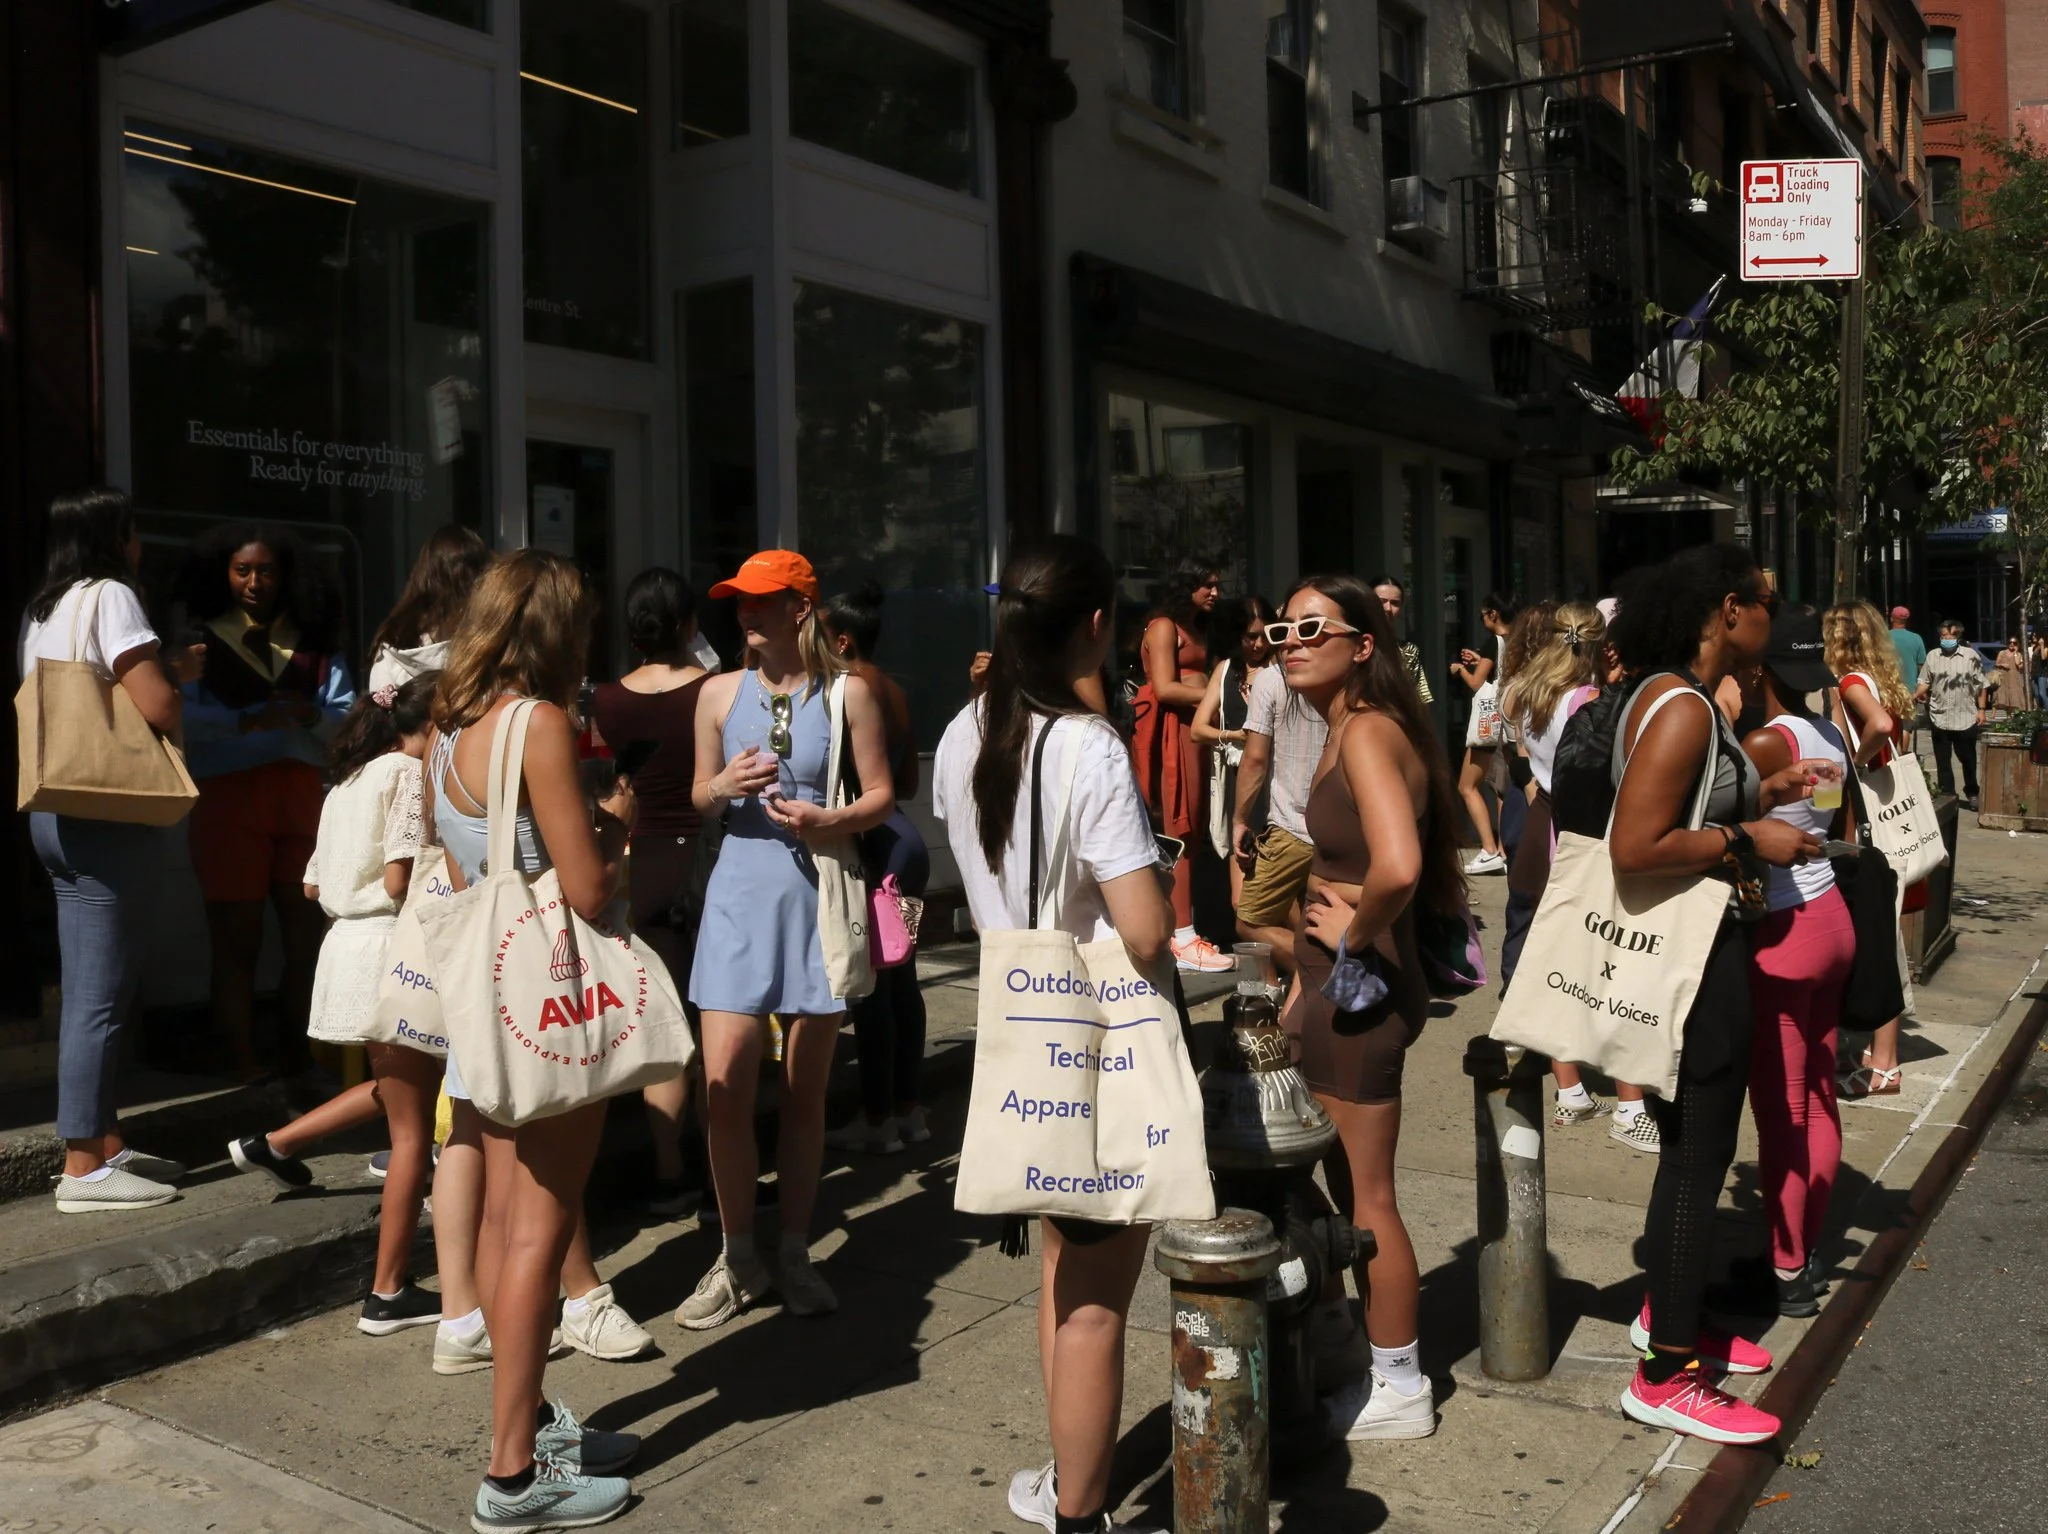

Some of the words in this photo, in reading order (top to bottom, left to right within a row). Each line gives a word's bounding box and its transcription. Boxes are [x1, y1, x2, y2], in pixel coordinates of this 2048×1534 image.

[1787, 167, 1818, 178] Truck
[1787, 179, 1829, 192] Loading
[1787, 192, 1811, 205] Only
[1748, 216, 1789, 228] Monday
[1800, 215, 1832, 228] Friday
[1748, 231, 1772, 242] 8am
[1782, 230, 1805, 243] 6pm
[522, 297, 561, 314] entre
[186, 419, 288, 454] Essentials
[292, 430, 321, 456] for
[250, 455, 312, 492] Ready
[316, 461, 344, 485] for
[348, 469, 427, 501] anything.
[1960, 519, 2003, 530] LEASE
[1584, 911, 1664, 956] GOLDE
[493, 930, 516, 983] THANK
[636, 967, 648, 1017] THANK
[1006, 968, 1092, 998] Outdoo
[1089, 977, 1159, 1004] Voices
[1547, 971, 1605, 1011] Outdoor
[1608, 997, 1660, 1027] Voices
[538, 981, 625, 1032] AWA
[498, 1005, 571, 1066] EXPLORING
[611, 1024, 637, 1049] YOU
[580, 1049, 607, 1066] FOR
[1146, 1124, 1170, 1149] for
[1025, 1166, 1145, 1194] Recreation
